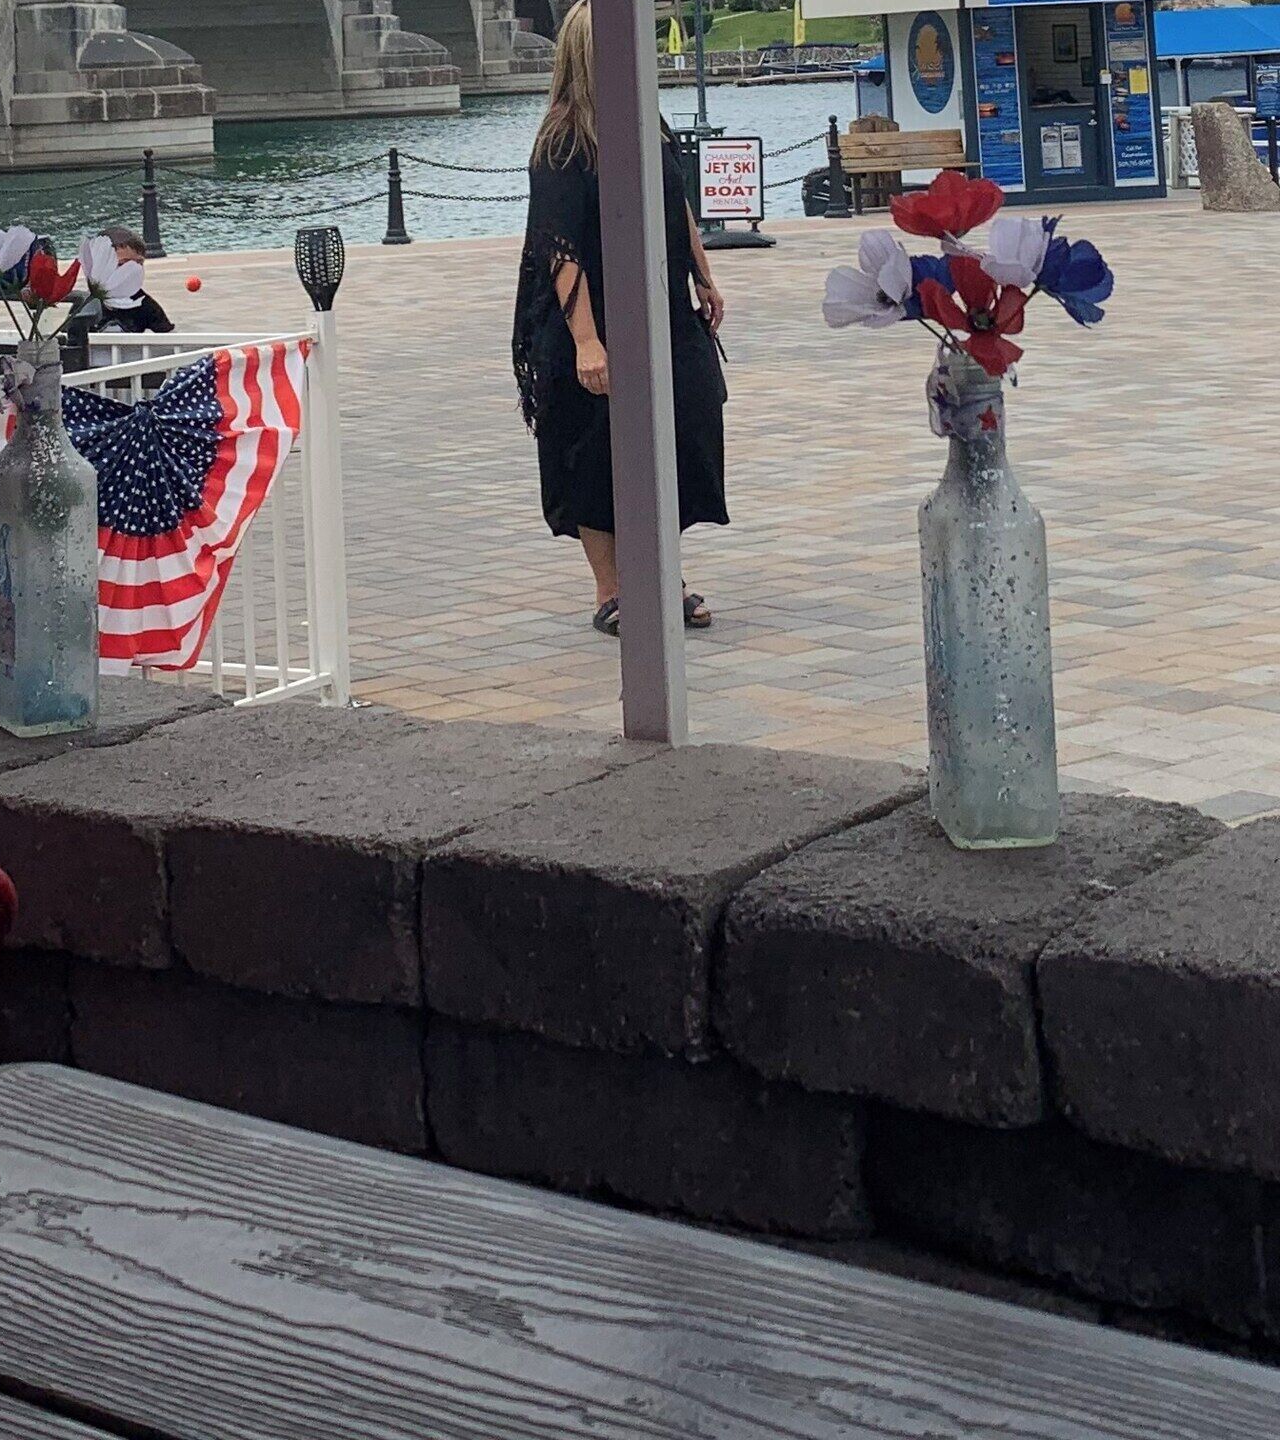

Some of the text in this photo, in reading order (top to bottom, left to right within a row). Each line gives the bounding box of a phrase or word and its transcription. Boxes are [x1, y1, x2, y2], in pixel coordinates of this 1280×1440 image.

[704, 153, 755, 162] CHAMPION
[704, 162, 755, 173] JET SKI
[705, 186, 756, 196] BOAT
